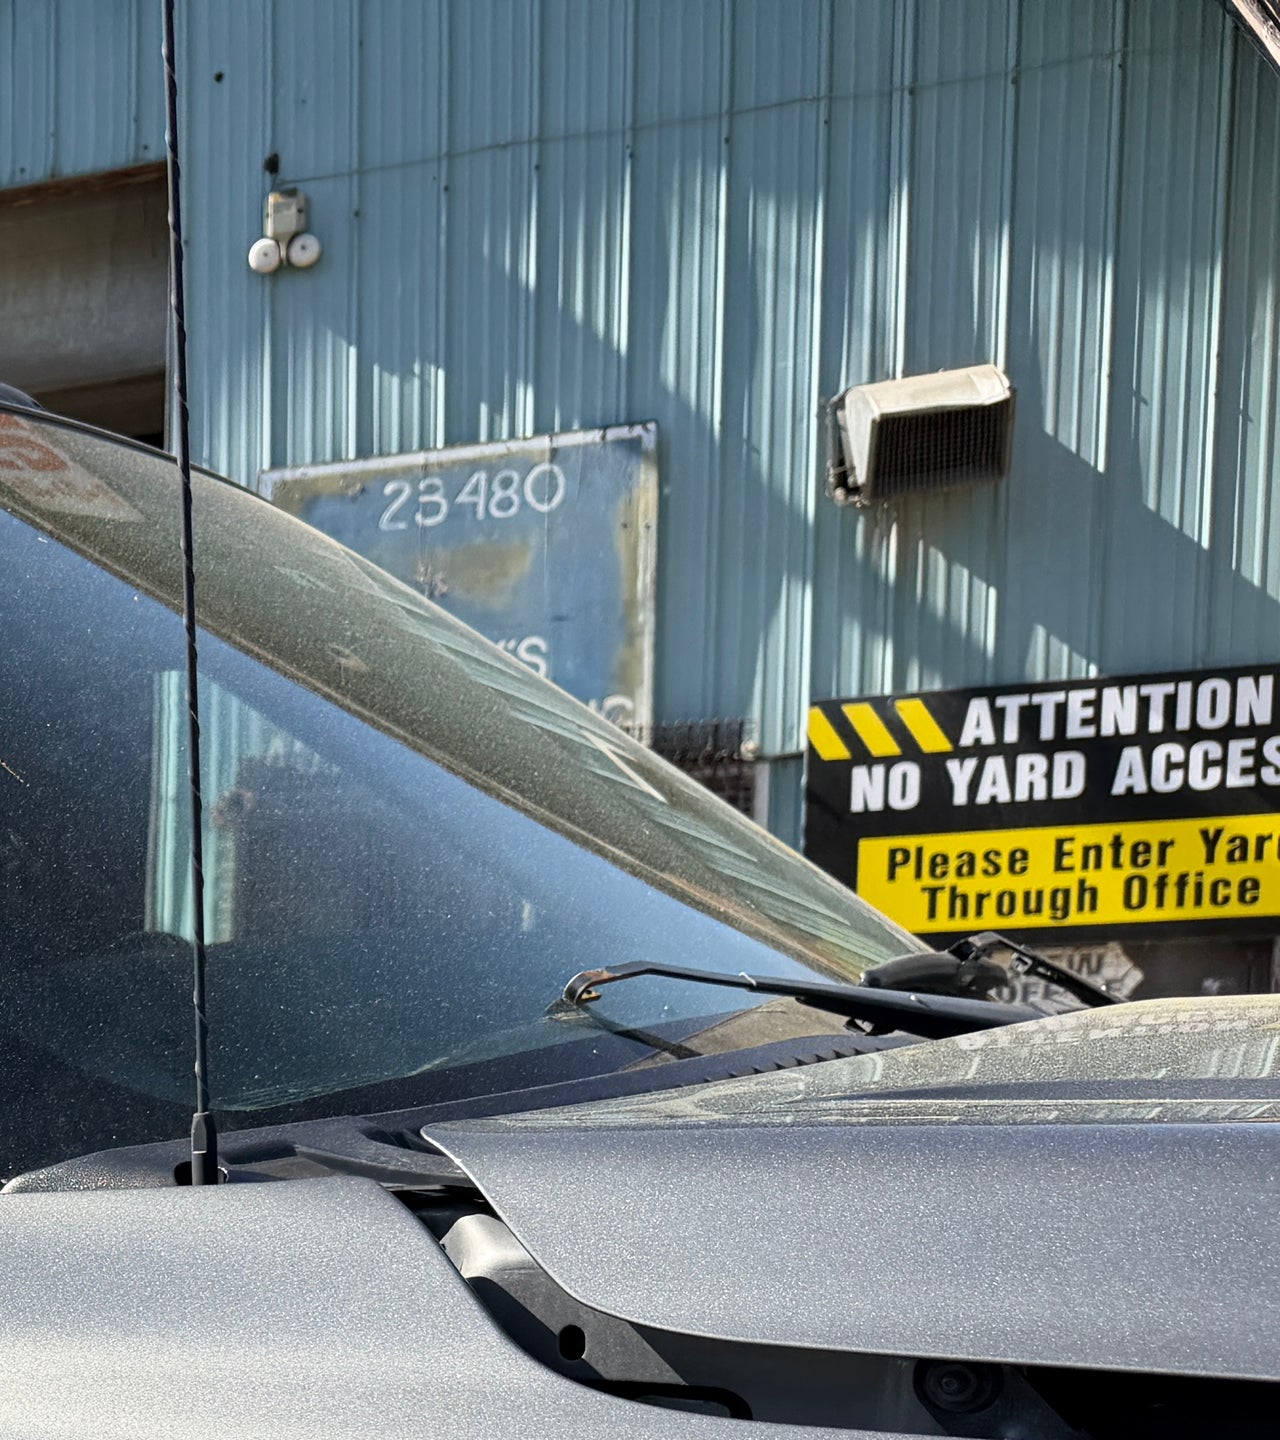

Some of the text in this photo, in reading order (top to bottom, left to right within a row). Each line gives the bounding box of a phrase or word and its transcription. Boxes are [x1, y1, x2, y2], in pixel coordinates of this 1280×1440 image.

[379, 462, 566, 531] 23480
[959, 674, 1274, 747] ATTENTION
[850, 761, 921, 813] NO
[946, 750, 1086, 806] YARD
[887, 827, 1280, 882] Please Enter Yar
[921, 871, 1262, 922] Through Office
